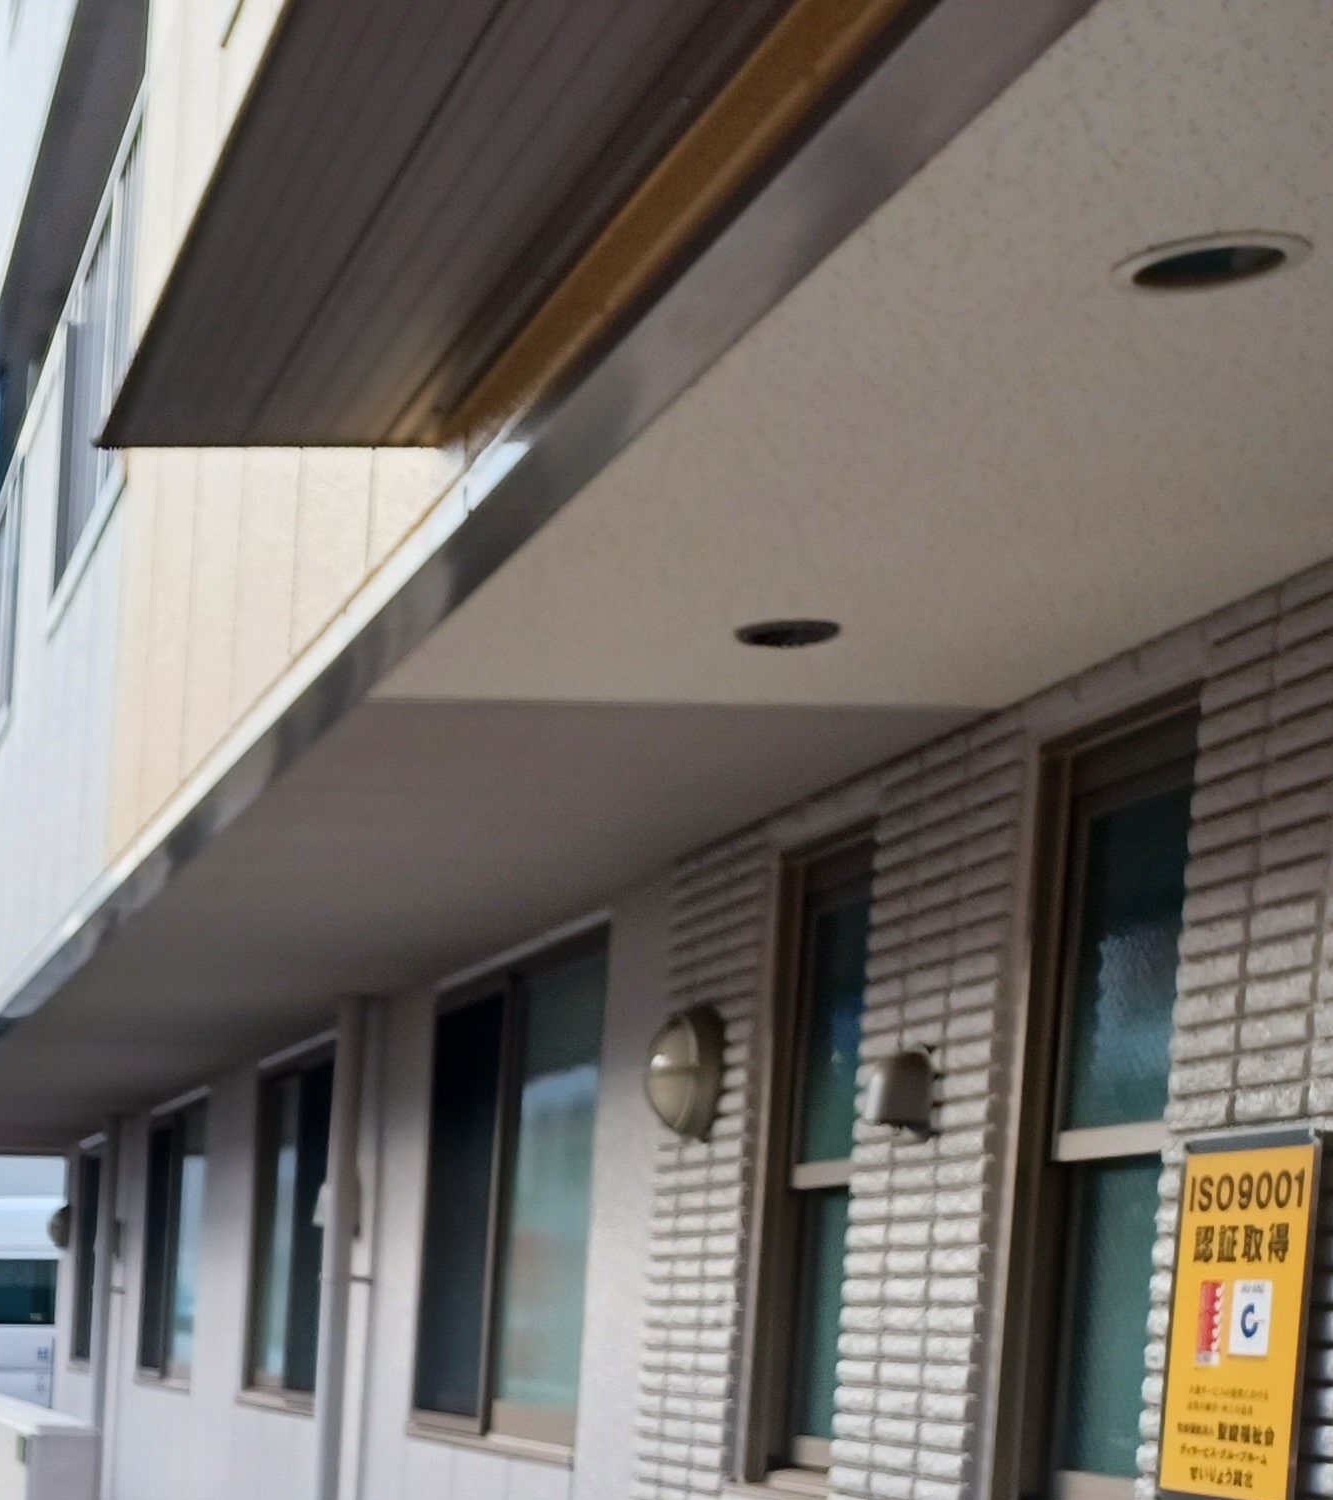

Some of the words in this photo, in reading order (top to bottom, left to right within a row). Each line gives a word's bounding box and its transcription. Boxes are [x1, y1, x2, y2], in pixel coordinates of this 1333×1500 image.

[1189, 1168, 1305, 1212] ISO9001
[1193, 1223, 1289, 1263] 認証取得
